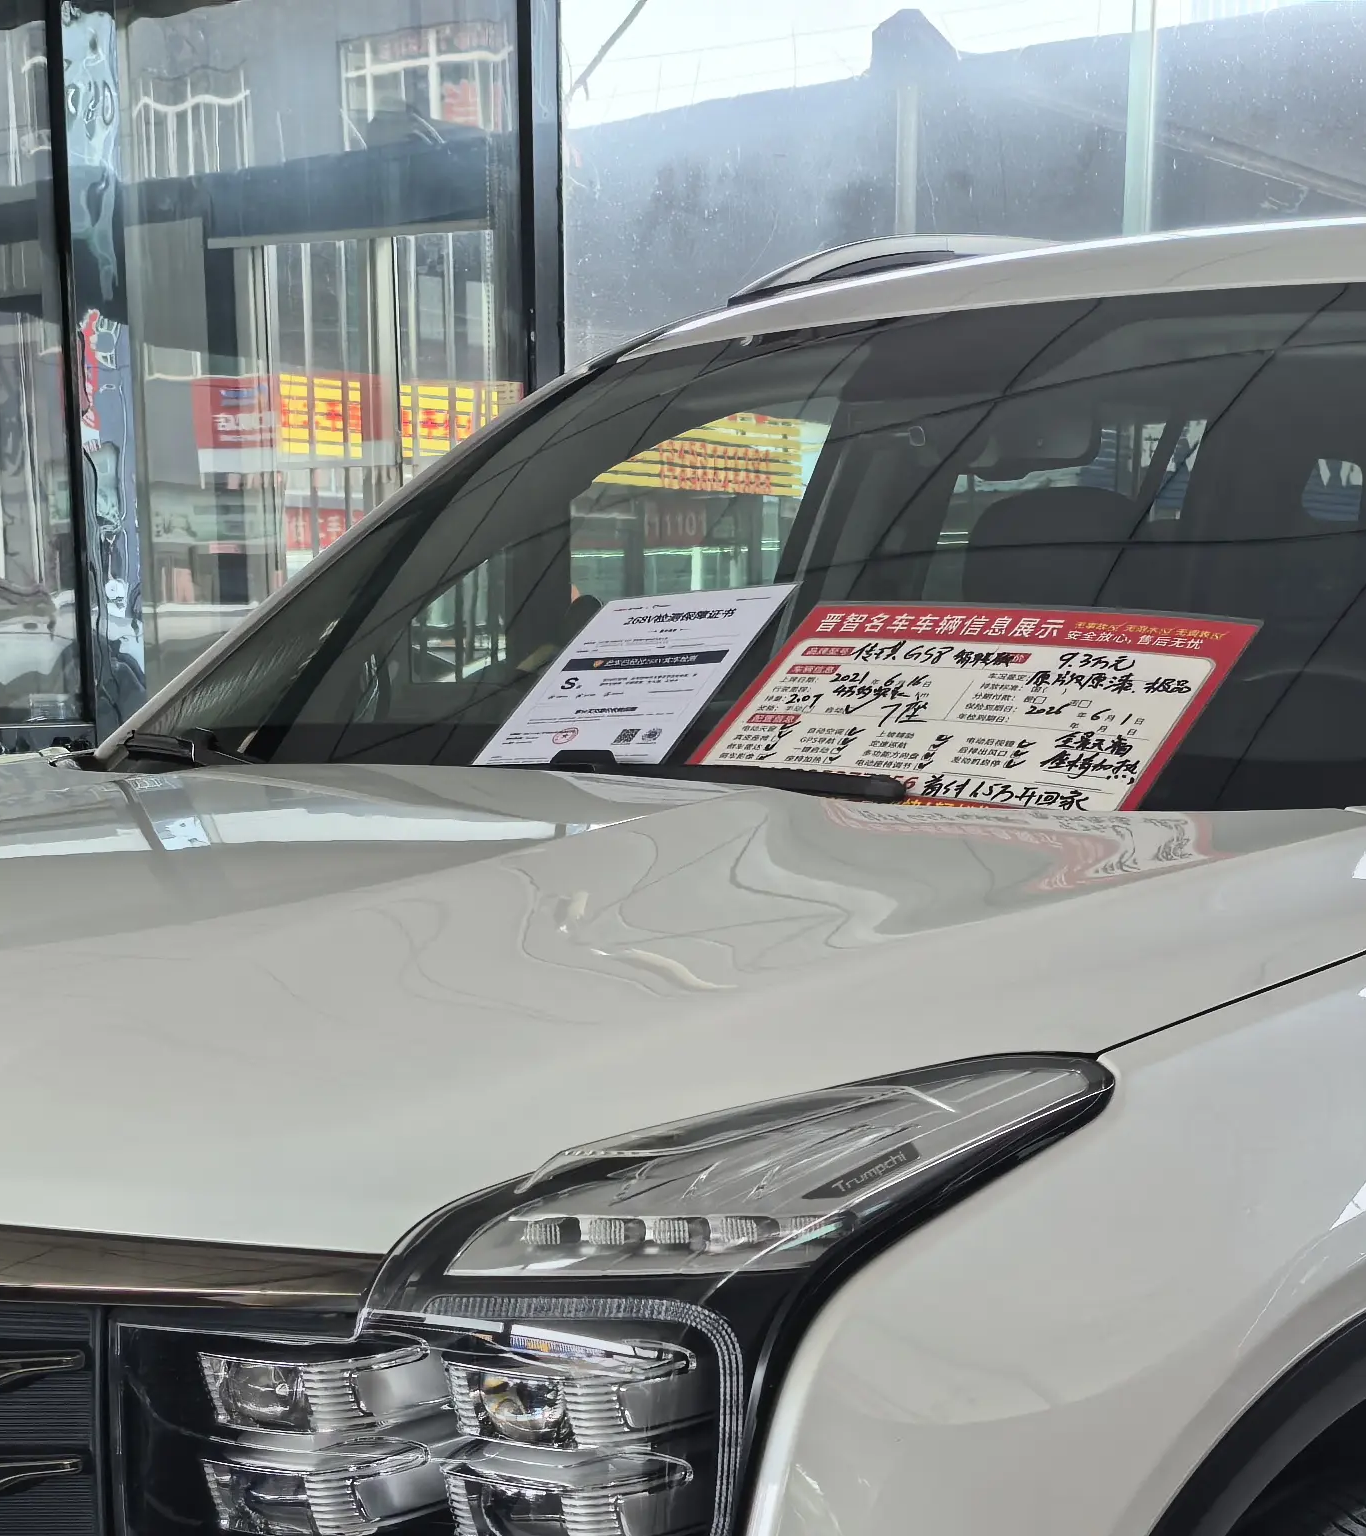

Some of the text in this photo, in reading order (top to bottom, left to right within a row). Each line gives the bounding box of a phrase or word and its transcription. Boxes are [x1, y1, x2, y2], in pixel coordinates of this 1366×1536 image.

[815, 612, 1065, 639] 晋智名车车辆信息展示
